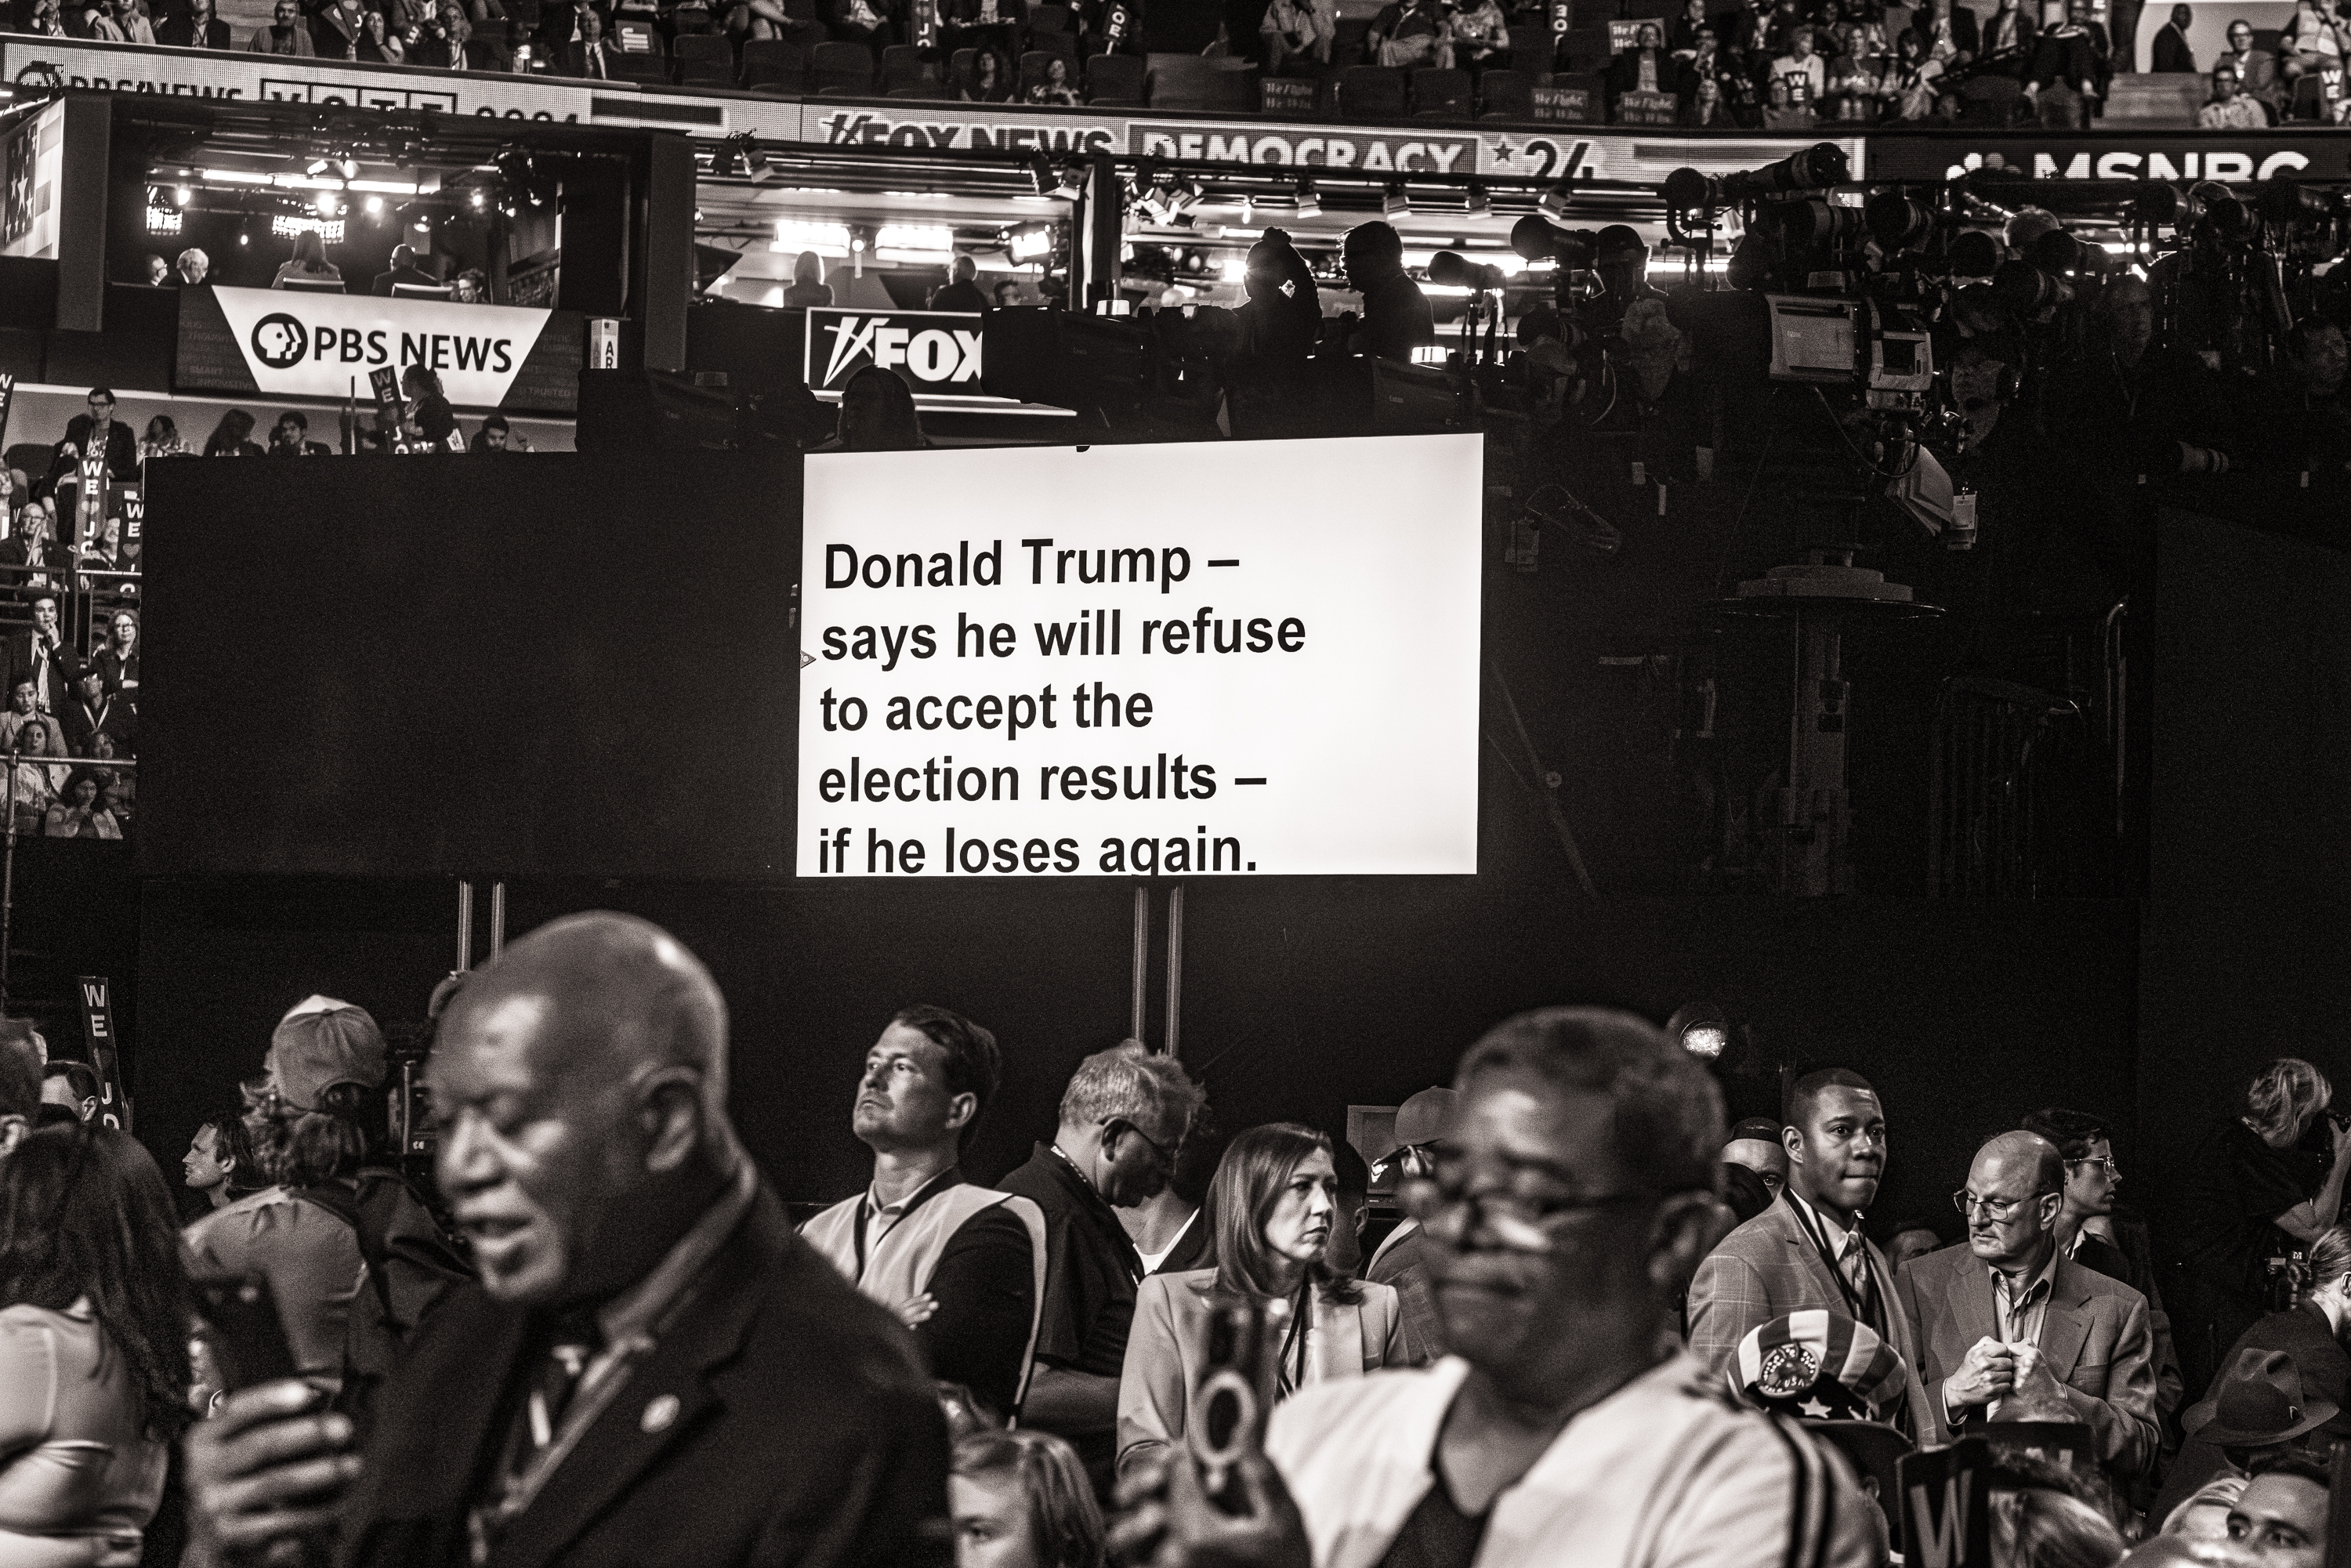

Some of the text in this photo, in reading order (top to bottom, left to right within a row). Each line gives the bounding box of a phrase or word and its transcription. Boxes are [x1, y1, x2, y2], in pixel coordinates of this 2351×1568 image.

[1788, 74, 1806, 100] WE
[2321, 70, 2342, 99] WE
[1143, 132, 1463, 172] DEMOCRACY
[315, 326, 512, 373] PBS NEWS
[875, 327, 983, 382] FOX
[374, 369, 394, 404] WE
[82, 460, 103, 495] WE
[127, 502, 144, 538] WE
[825, 539, 1002, 589] Donald
[1021, 538, 1190, 594] Trump
[822, 607, 1306, 672] says he will refuse
[820, 682, 1153, 741] to accept the
[819, 755, 1019, 803] election
[1041, 753, 1216, 801] results
[820, 825, 1256, 876] if he loses again.
[83, 983, 108, 1037] WE
[1784, 1375, 1805, 1389] USA
